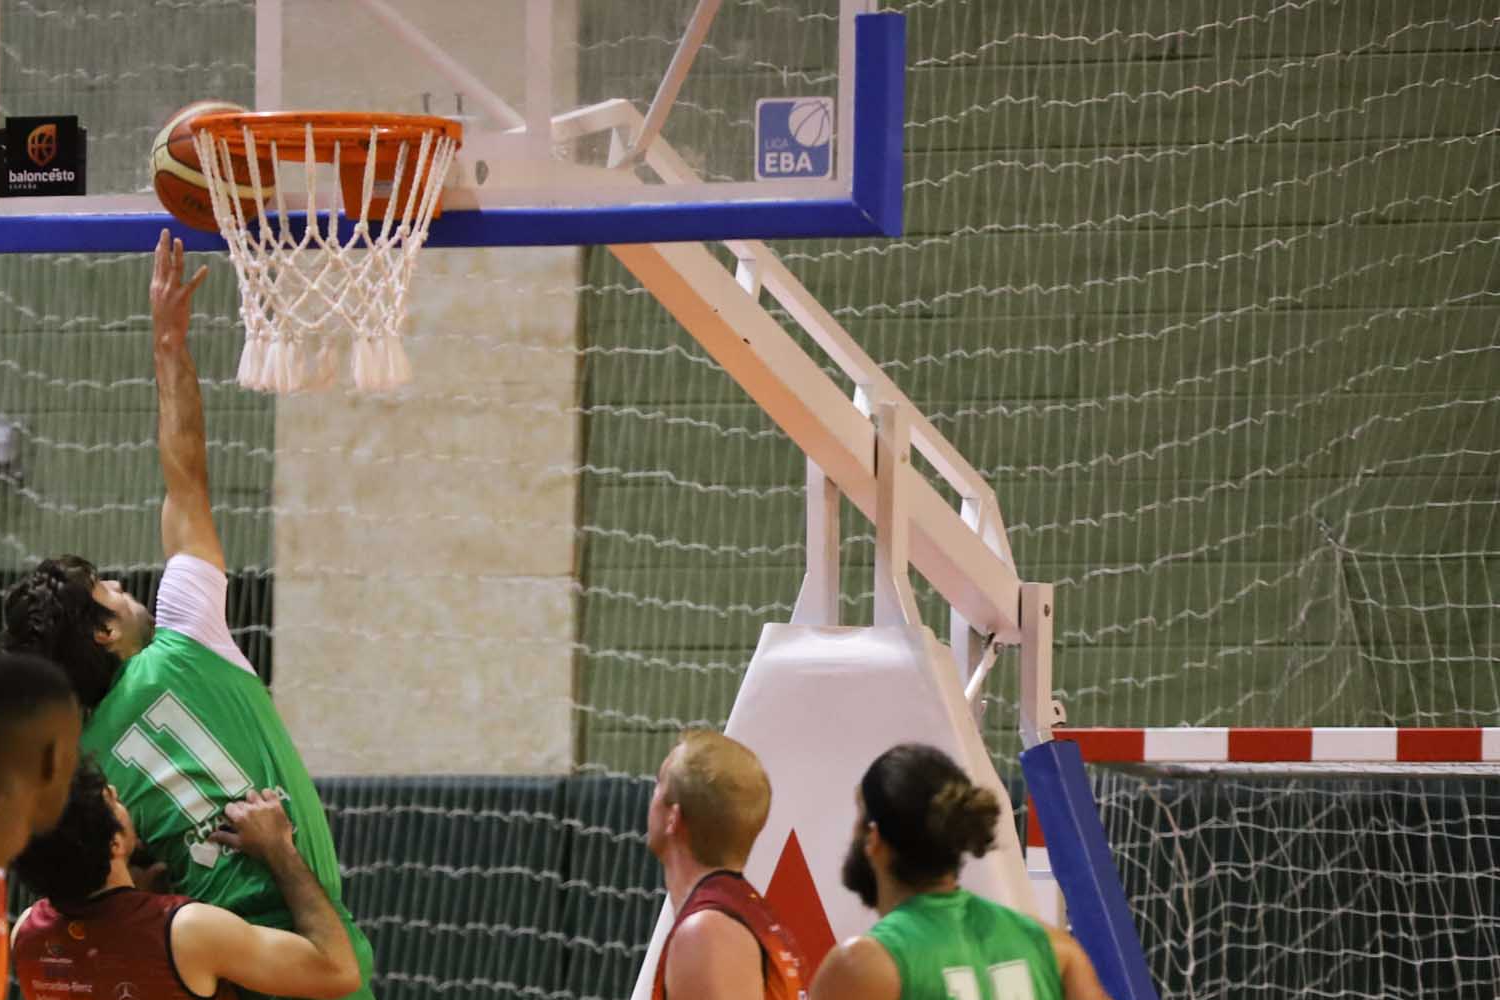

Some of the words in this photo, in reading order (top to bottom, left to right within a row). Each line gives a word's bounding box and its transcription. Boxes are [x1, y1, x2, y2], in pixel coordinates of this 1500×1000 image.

[765, 151, 813, 173] EBA
[8, 168, 75, 183] baloncesto
[111, 688, 255, 824] 11
